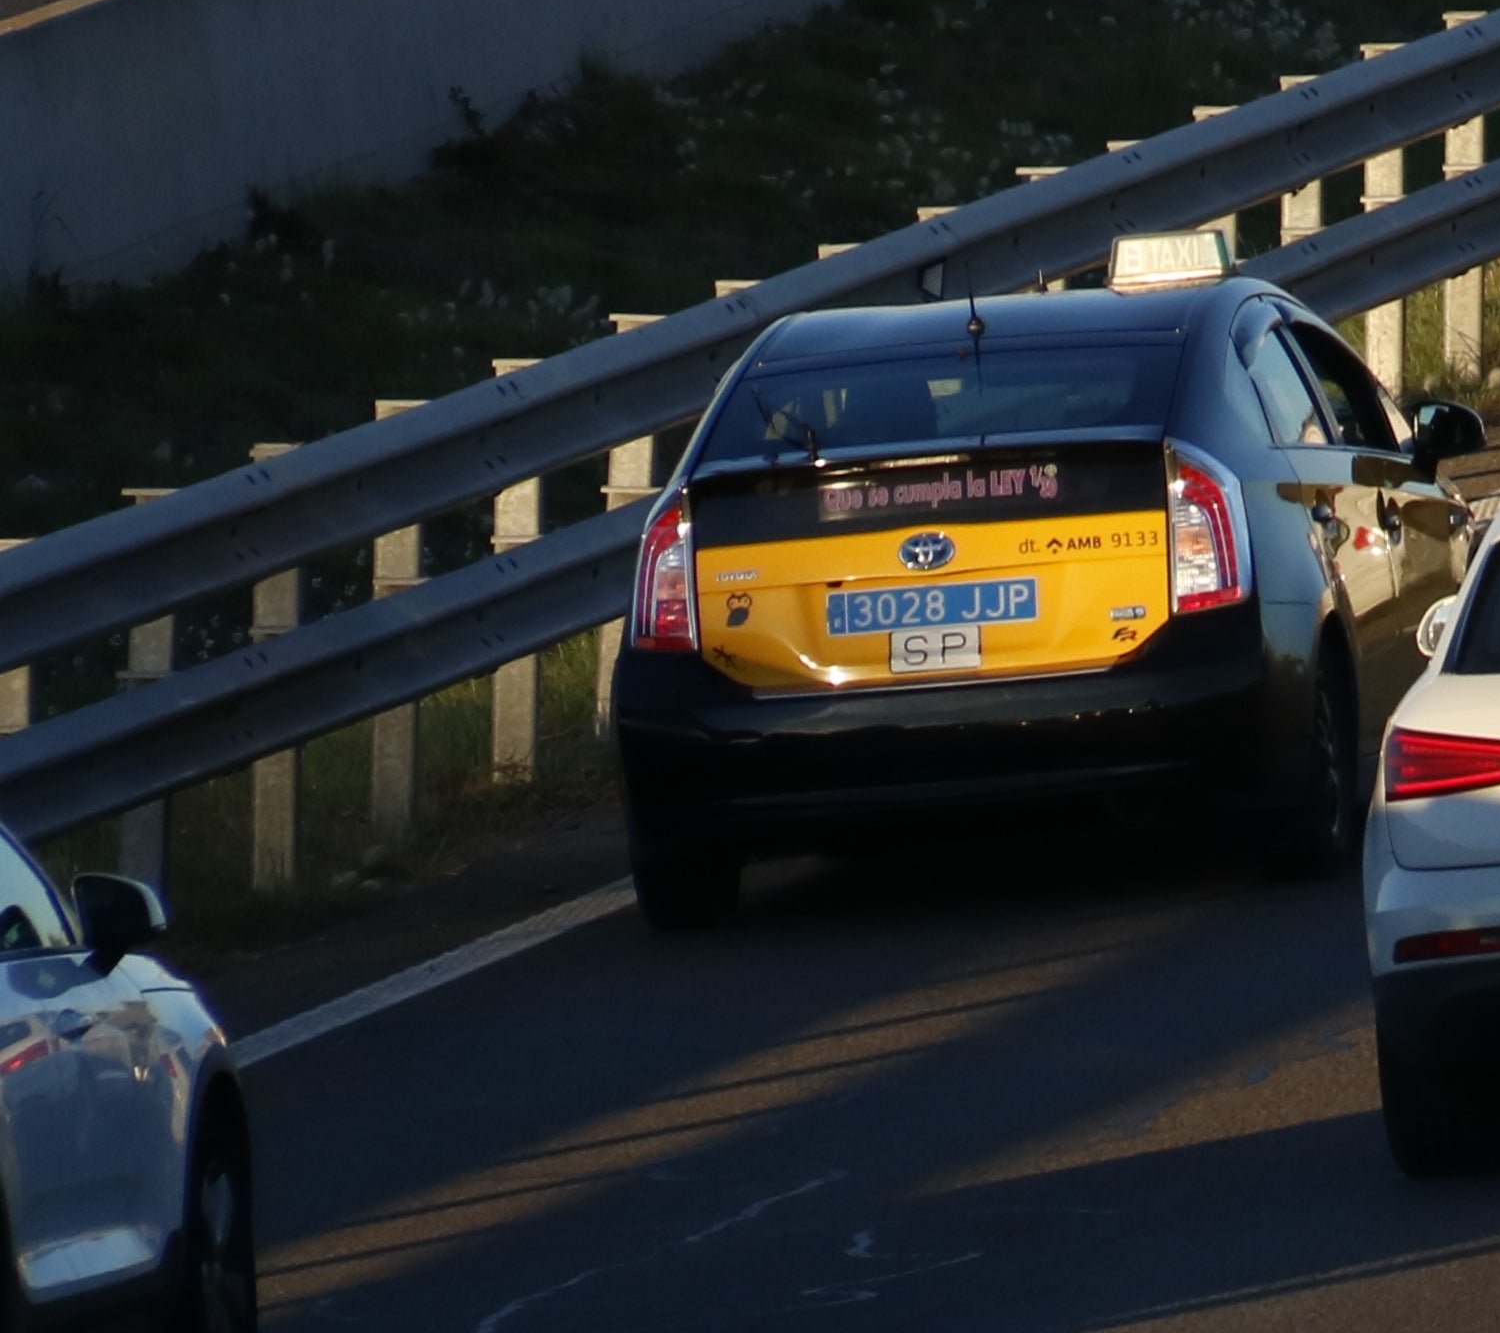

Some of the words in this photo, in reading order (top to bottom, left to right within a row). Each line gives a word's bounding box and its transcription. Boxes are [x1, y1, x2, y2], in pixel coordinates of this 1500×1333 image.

[1150, 236, 1199, 271] TAXI
[893, 472, 962, 509] cumpla
[966, 470, 986, 499] la
[989, 469, 1027, 497] LEY
[1018, 536, 1040, 555] dt.
[1066, 537, 1102, 551] AMB
[1110, 531, 1159, 548] 9133
[854, 589, 946, 627] 3028
[961, 584, 1029, 619] JJP
